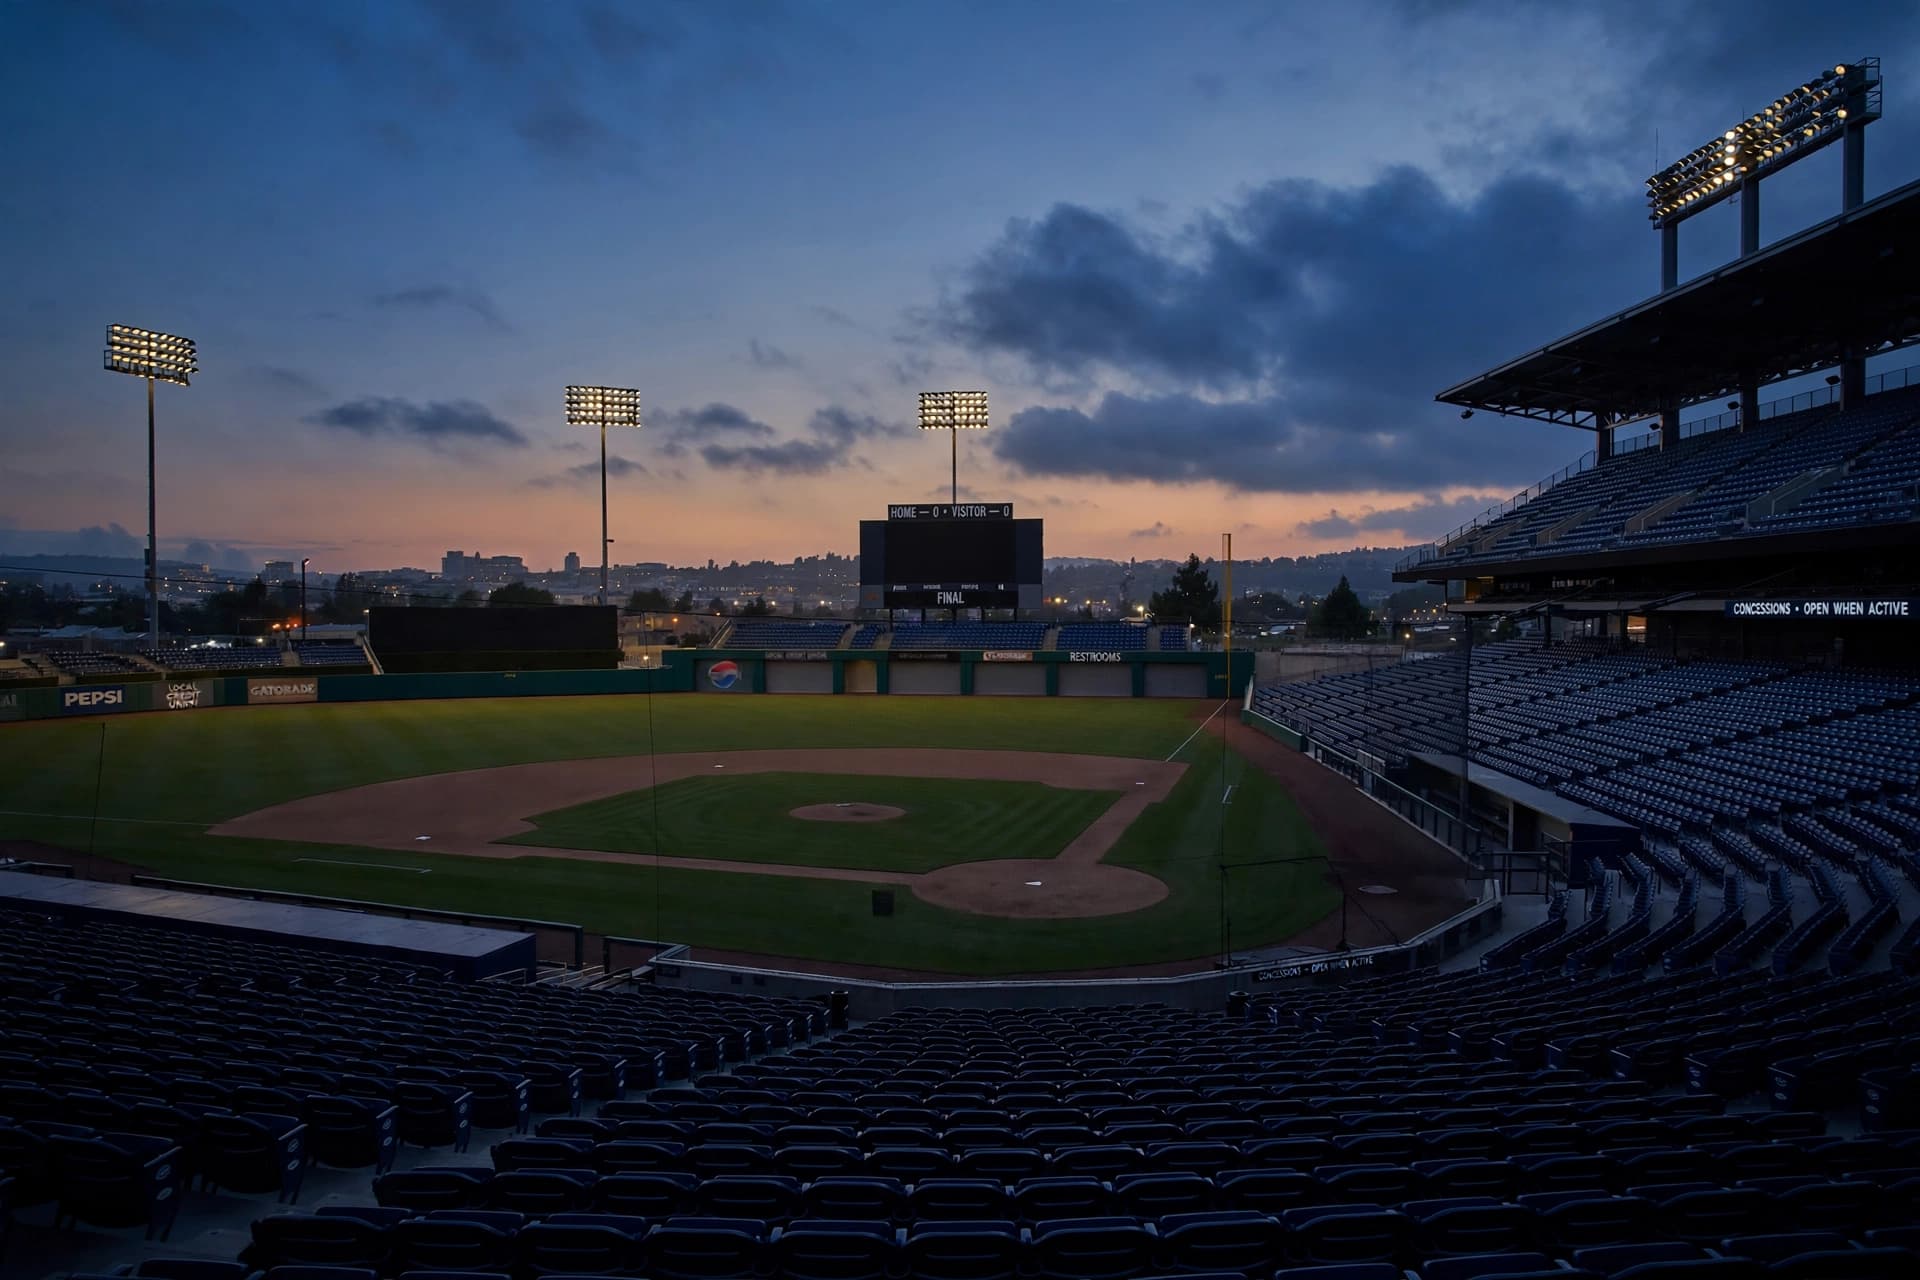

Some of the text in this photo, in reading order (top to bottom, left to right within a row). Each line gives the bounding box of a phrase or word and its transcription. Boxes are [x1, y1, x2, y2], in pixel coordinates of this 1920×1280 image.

[891, 506, 917, 518] HOME
[952, 505, 986, 517] VISITOR
[937, 591, 965, 604] FINAL
[1733, 601, 1909, 616] CONCESSIONS OPEN WHEN ACTIVE
[250, 684, 315, 696] GATORADE
[64, 689, 123, 707] PEPSI
